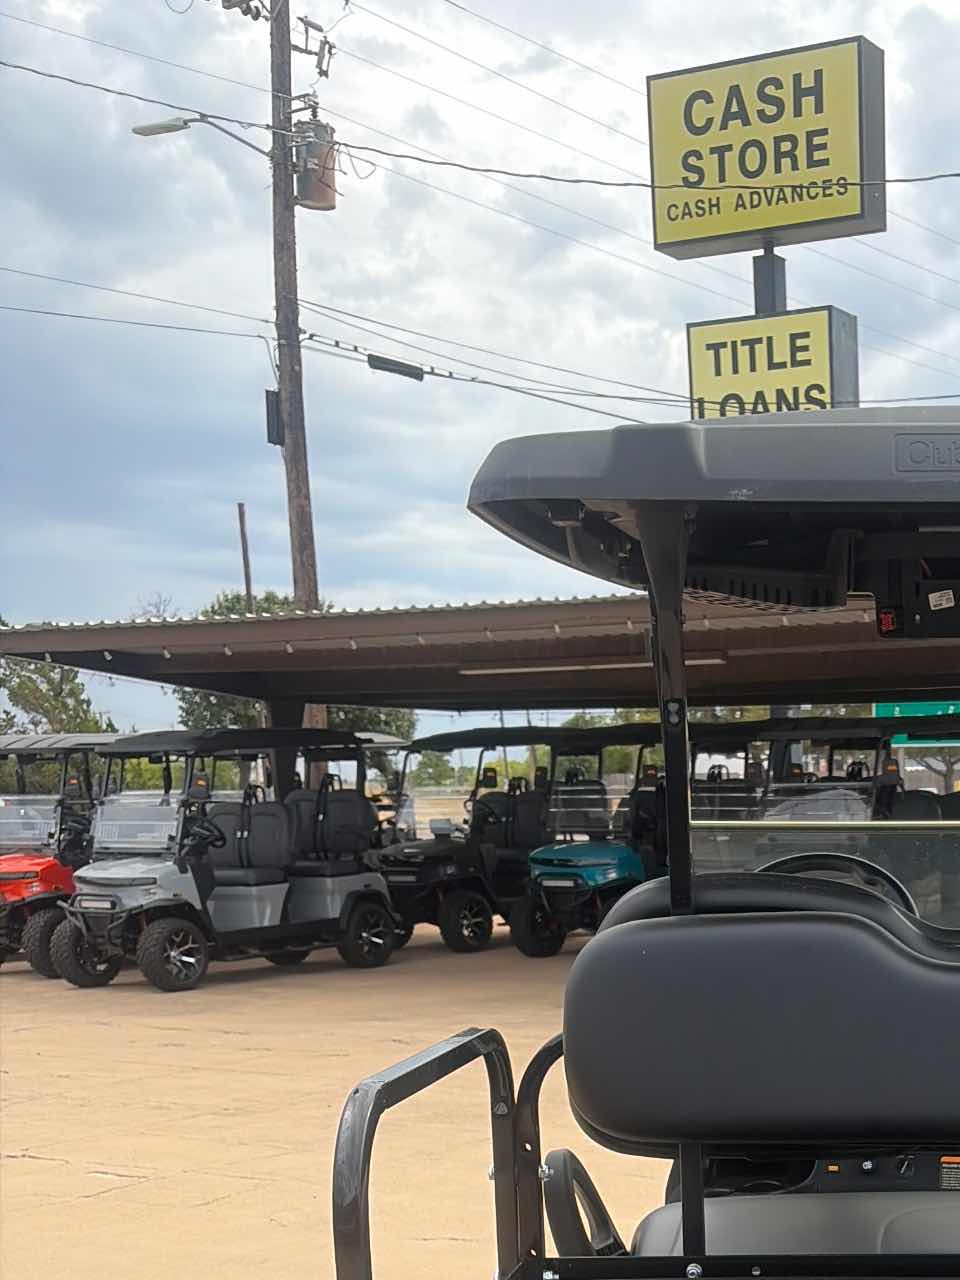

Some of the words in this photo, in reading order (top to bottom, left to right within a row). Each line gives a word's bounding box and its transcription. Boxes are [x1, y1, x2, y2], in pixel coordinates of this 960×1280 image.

[683, 69, 824, 136] CASH
[681, 128, 830, 188] STORE
[667, 197, 721, 222] CASH
[734, 176, 848, 211] ADVANCES
[706, 331, 811, 376] TITLE
